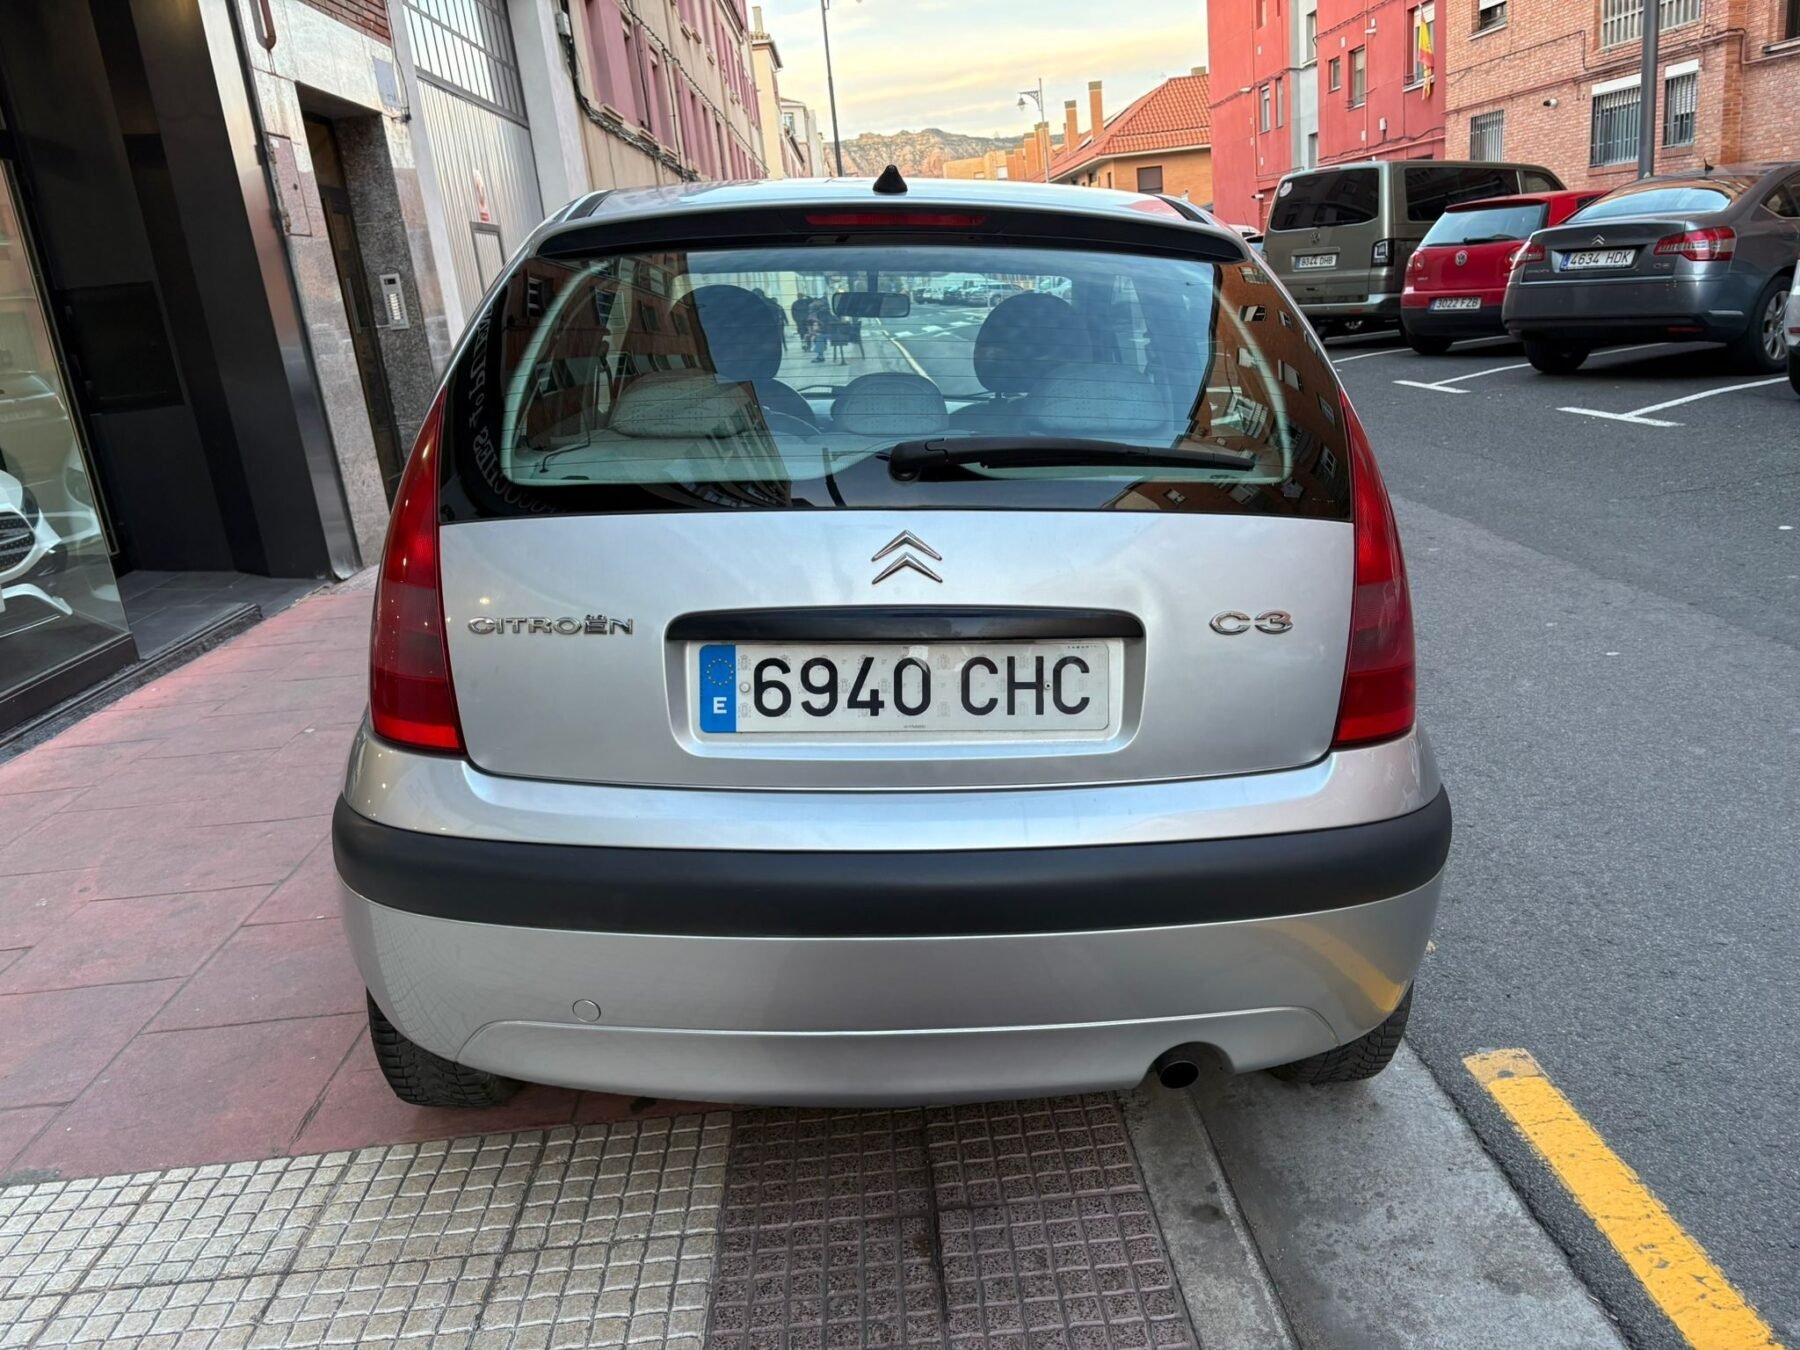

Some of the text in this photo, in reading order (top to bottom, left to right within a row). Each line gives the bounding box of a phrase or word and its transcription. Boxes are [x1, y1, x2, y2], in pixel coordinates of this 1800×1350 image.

[1570, 251, 1631, 265] 4634 HDK
[1436, 298, 1479, 309] 3022 FZB
[467, 614, 633, 635] CITROËN
[1209, 611, 1293, 635] C3
[753, 656, 1090, 717] 6940 CHC
[713, 697, 727, 714] E
